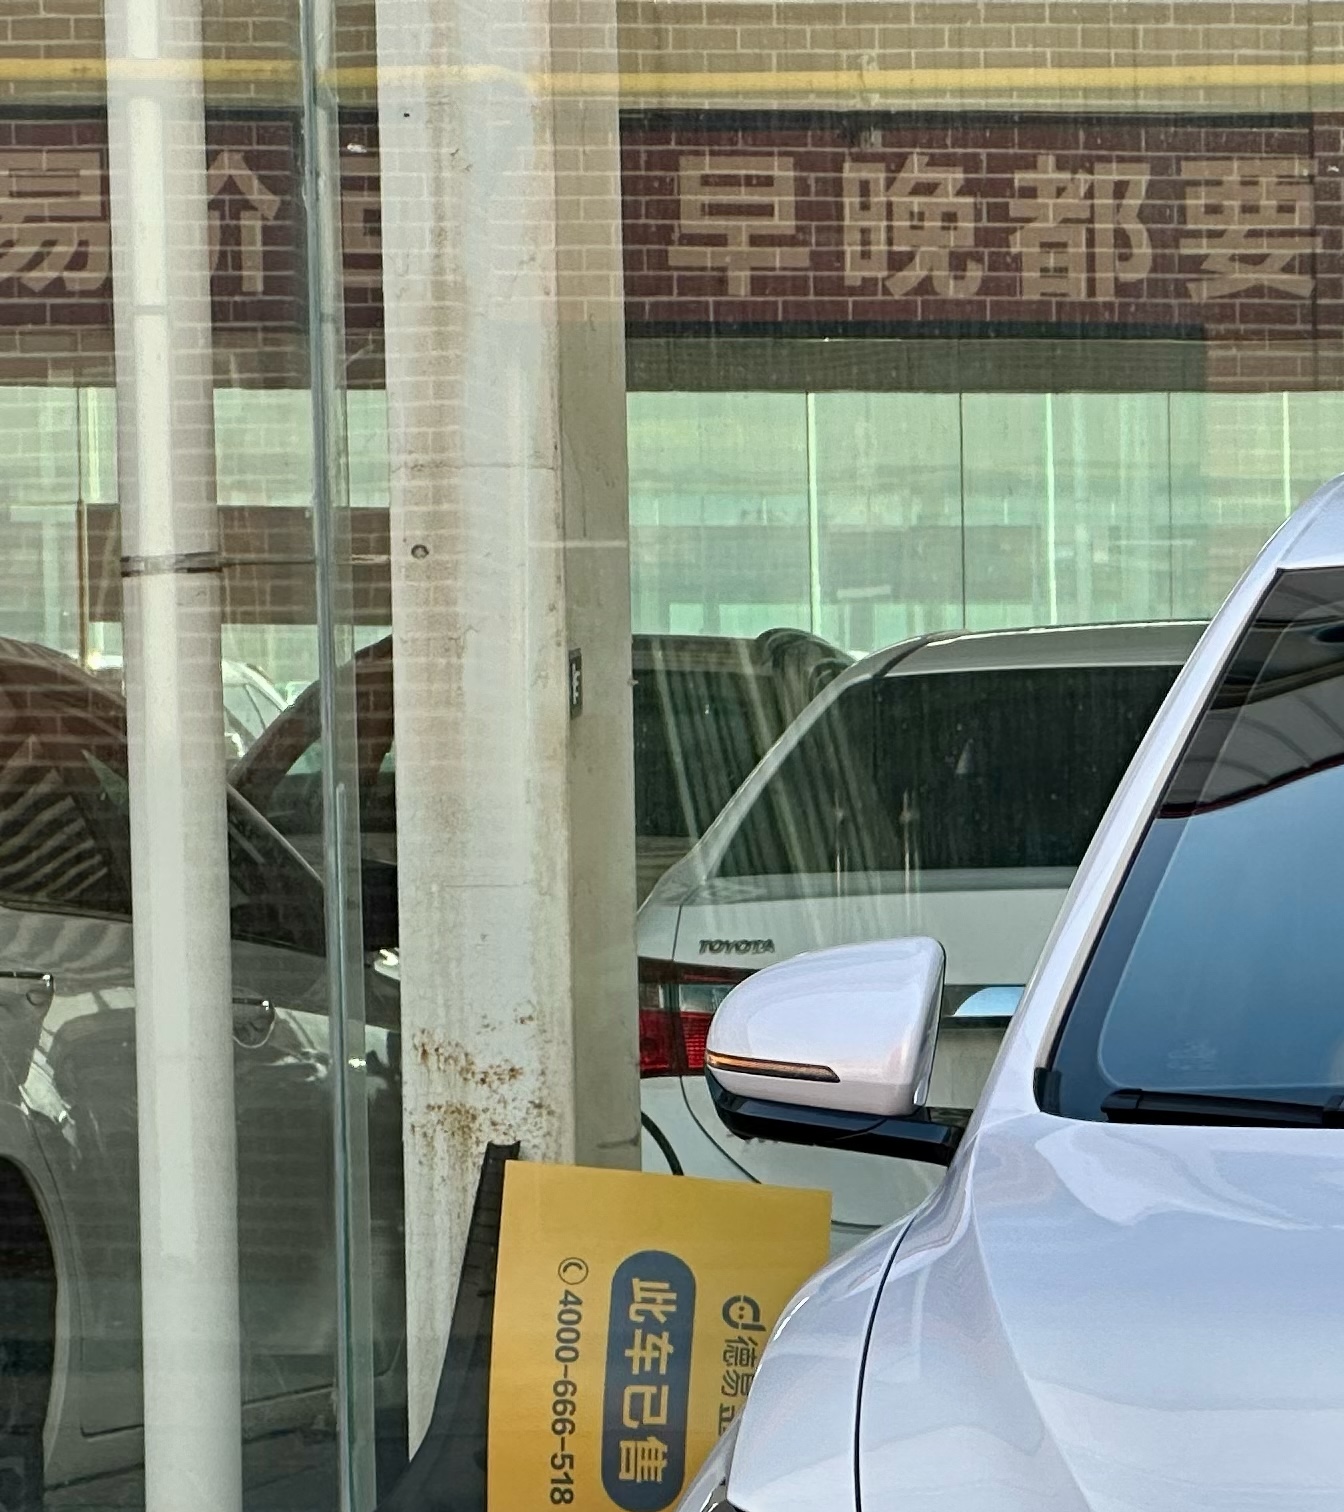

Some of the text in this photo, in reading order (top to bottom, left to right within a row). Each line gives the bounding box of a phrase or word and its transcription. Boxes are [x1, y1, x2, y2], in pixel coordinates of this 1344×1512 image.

[699, 938, 775, 955] TOYOTA
[550, 1288, 582, 1506] 4000-666-518
[618, 1276, 677, 1485] 此车已售
